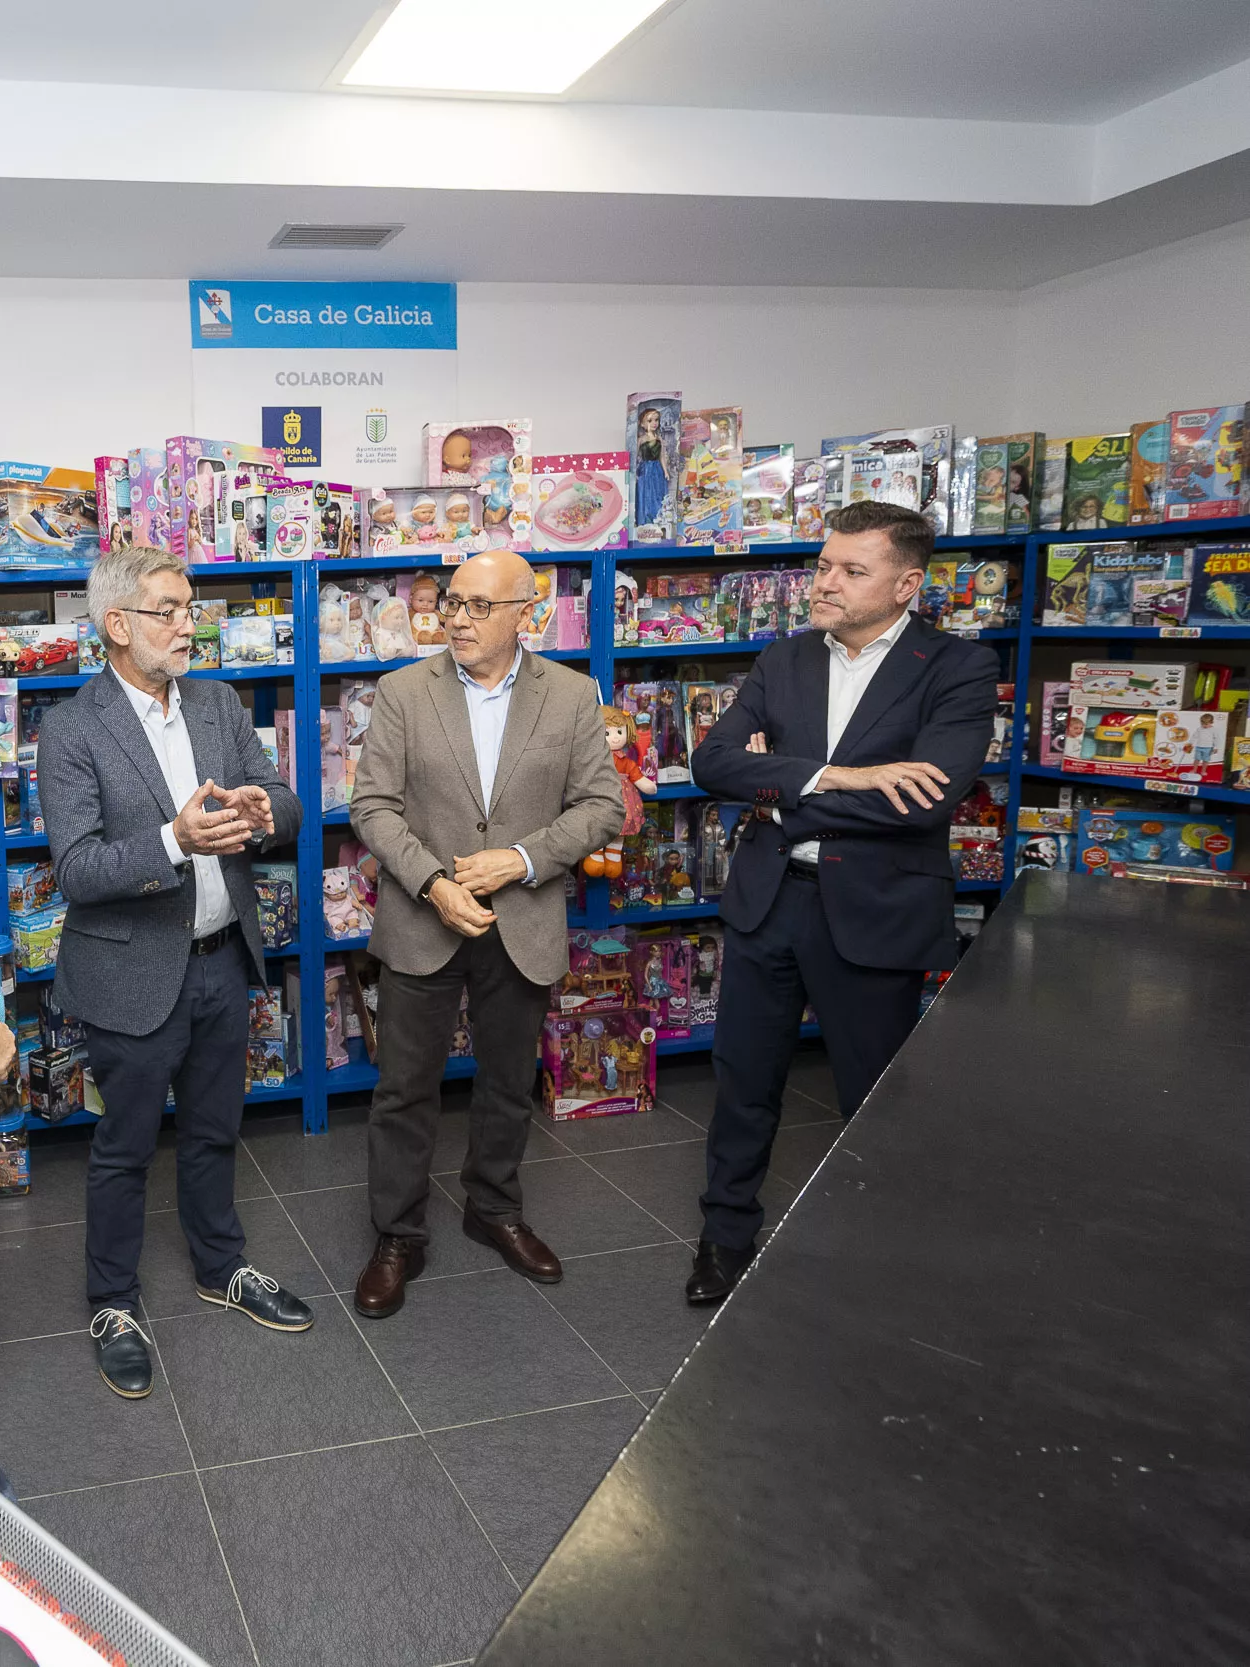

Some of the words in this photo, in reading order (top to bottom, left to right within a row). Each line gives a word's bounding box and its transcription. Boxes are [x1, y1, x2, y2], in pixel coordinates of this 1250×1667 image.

[254, 304, 312, 324] Casa
[319, 305, 348, 324] de
[354, 304, 433, 326] Galicia
[275, 372, 383, 386] COLABORAN
[272, 447, 300, 455] bildo
[287, 455, 317, 463] Canaria
[9, 465, 42, 477] playmobil
[272, 487, 291, 497] Beads
[1204, 560, 1231, 573] SEA
